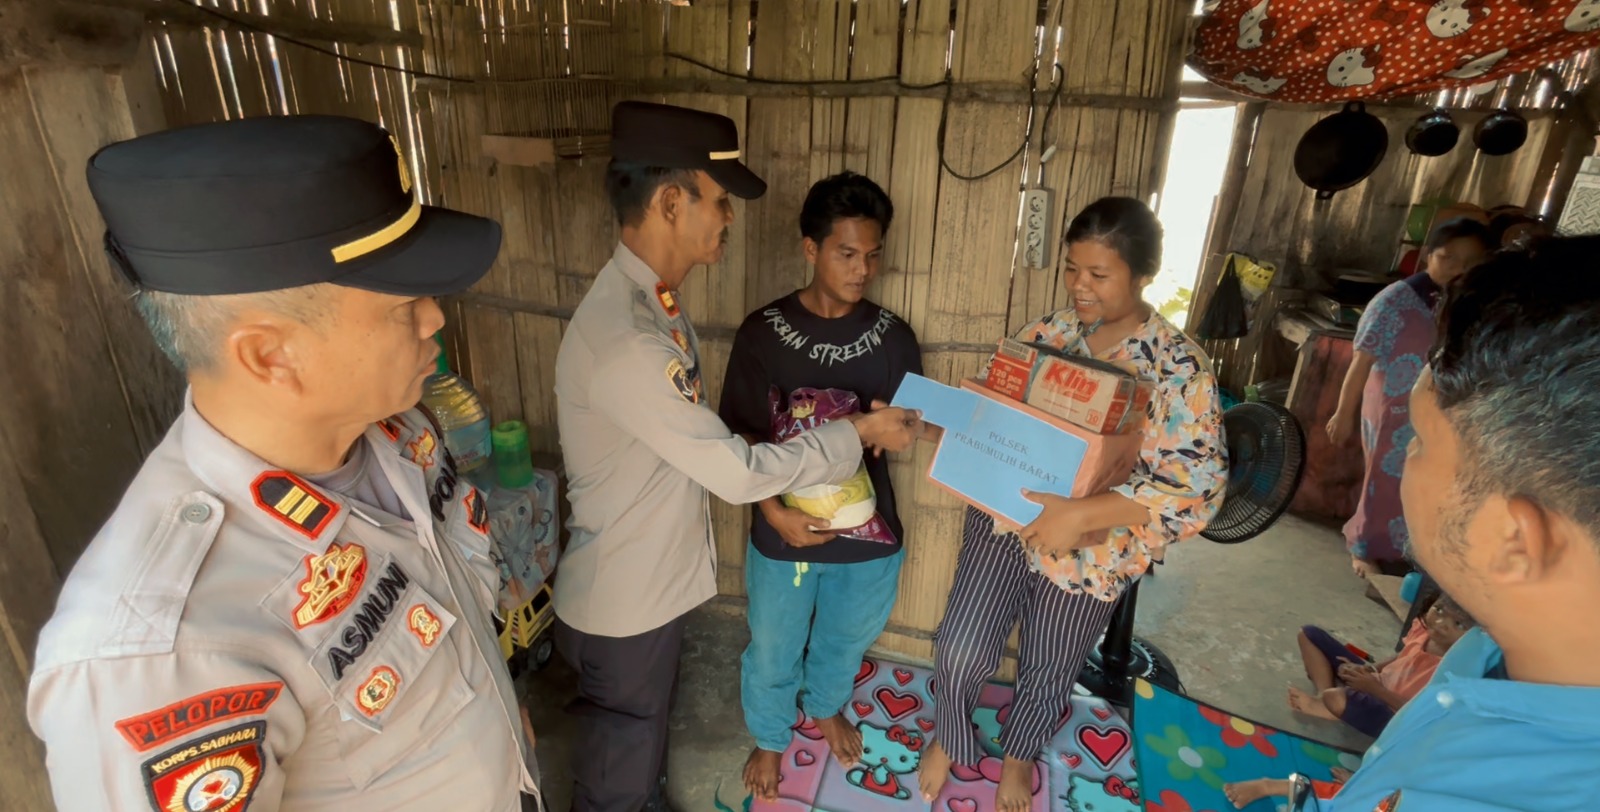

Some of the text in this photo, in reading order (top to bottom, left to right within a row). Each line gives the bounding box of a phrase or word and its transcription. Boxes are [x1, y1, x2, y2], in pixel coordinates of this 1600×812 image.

[763, 307, 810, 350] URBAN
[1043, 361, 1100, 396] Klin
[954, 431, 1060, 485] PRABUMULIH BARAT
[988, 430, 1030, 455] POLSEK
[328, 561, 409, 681] ASMUNI
[127, 690, 266, 745] PELOPOR
